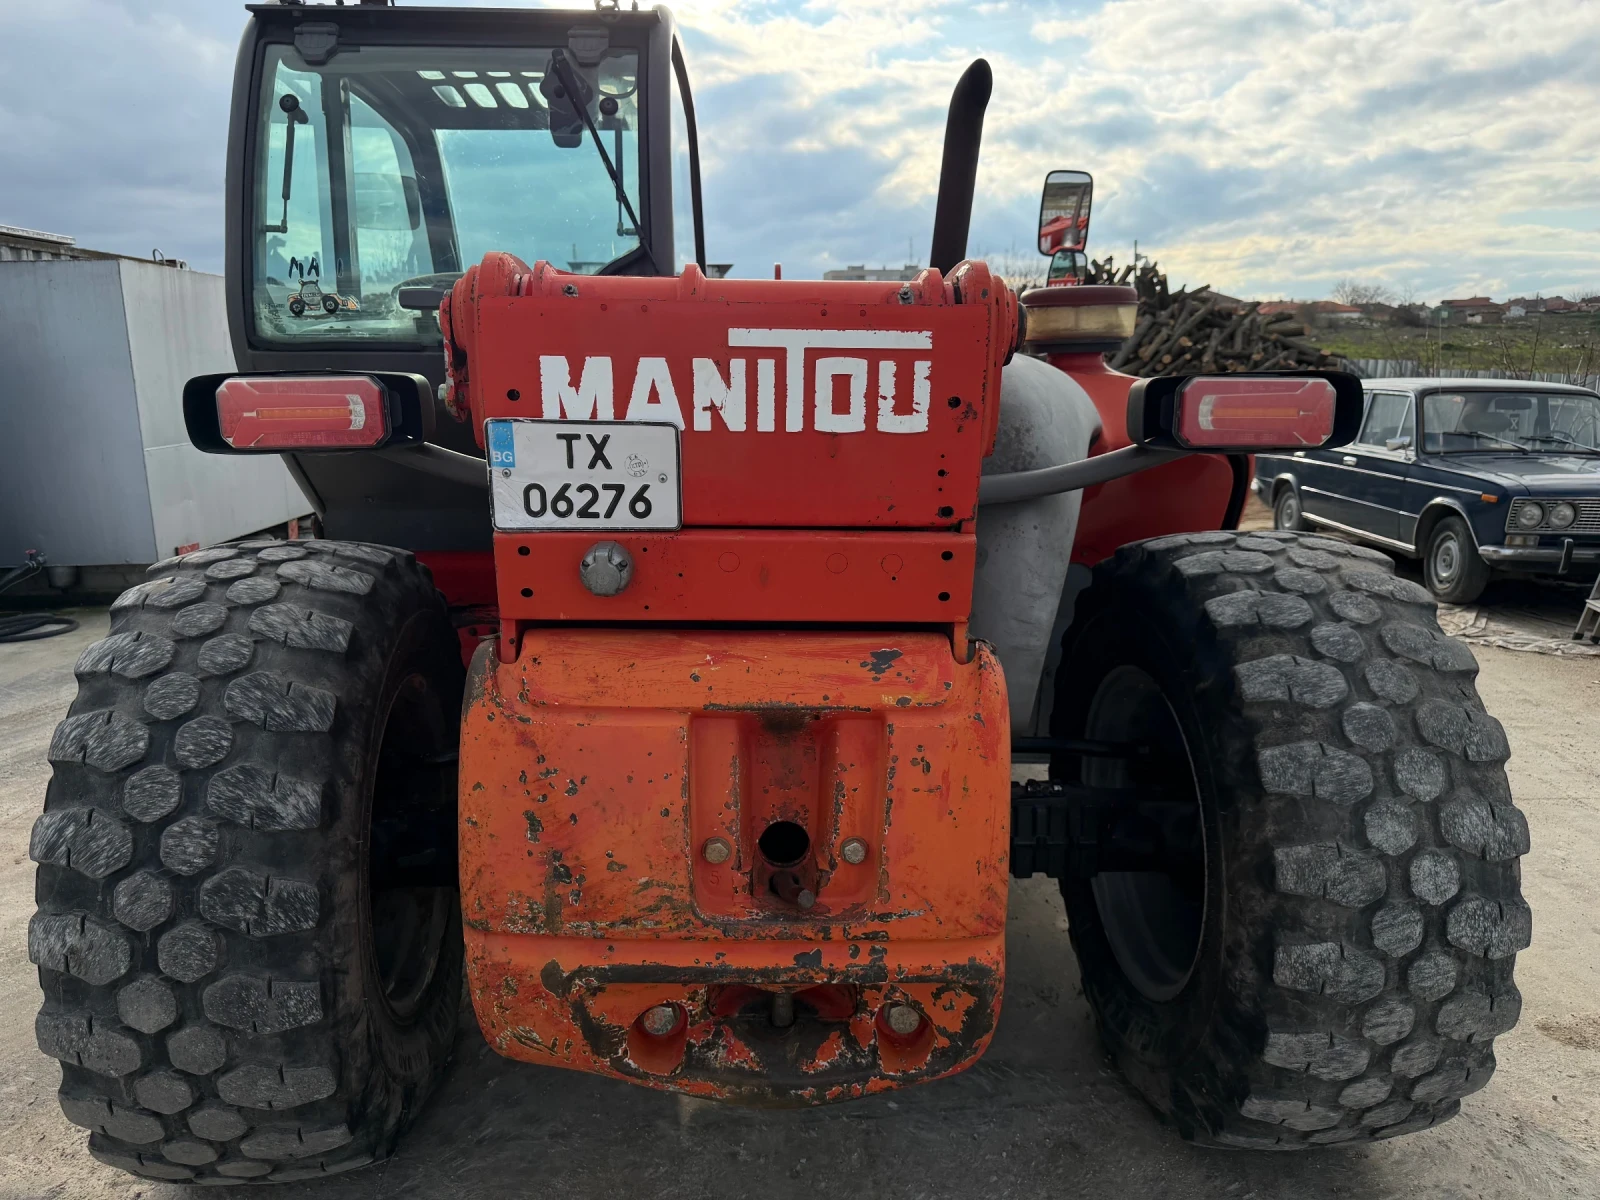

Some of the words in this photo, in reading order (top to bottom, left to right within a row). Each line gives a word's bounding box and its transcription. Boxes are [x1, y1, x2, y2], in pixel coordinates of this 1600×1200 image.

[539, 327, 933, 434] MANITOU
[492, 451, 514, 464] BG
[555, 432, 613, 470] TX
[522, 482, 653, 519] 06276
